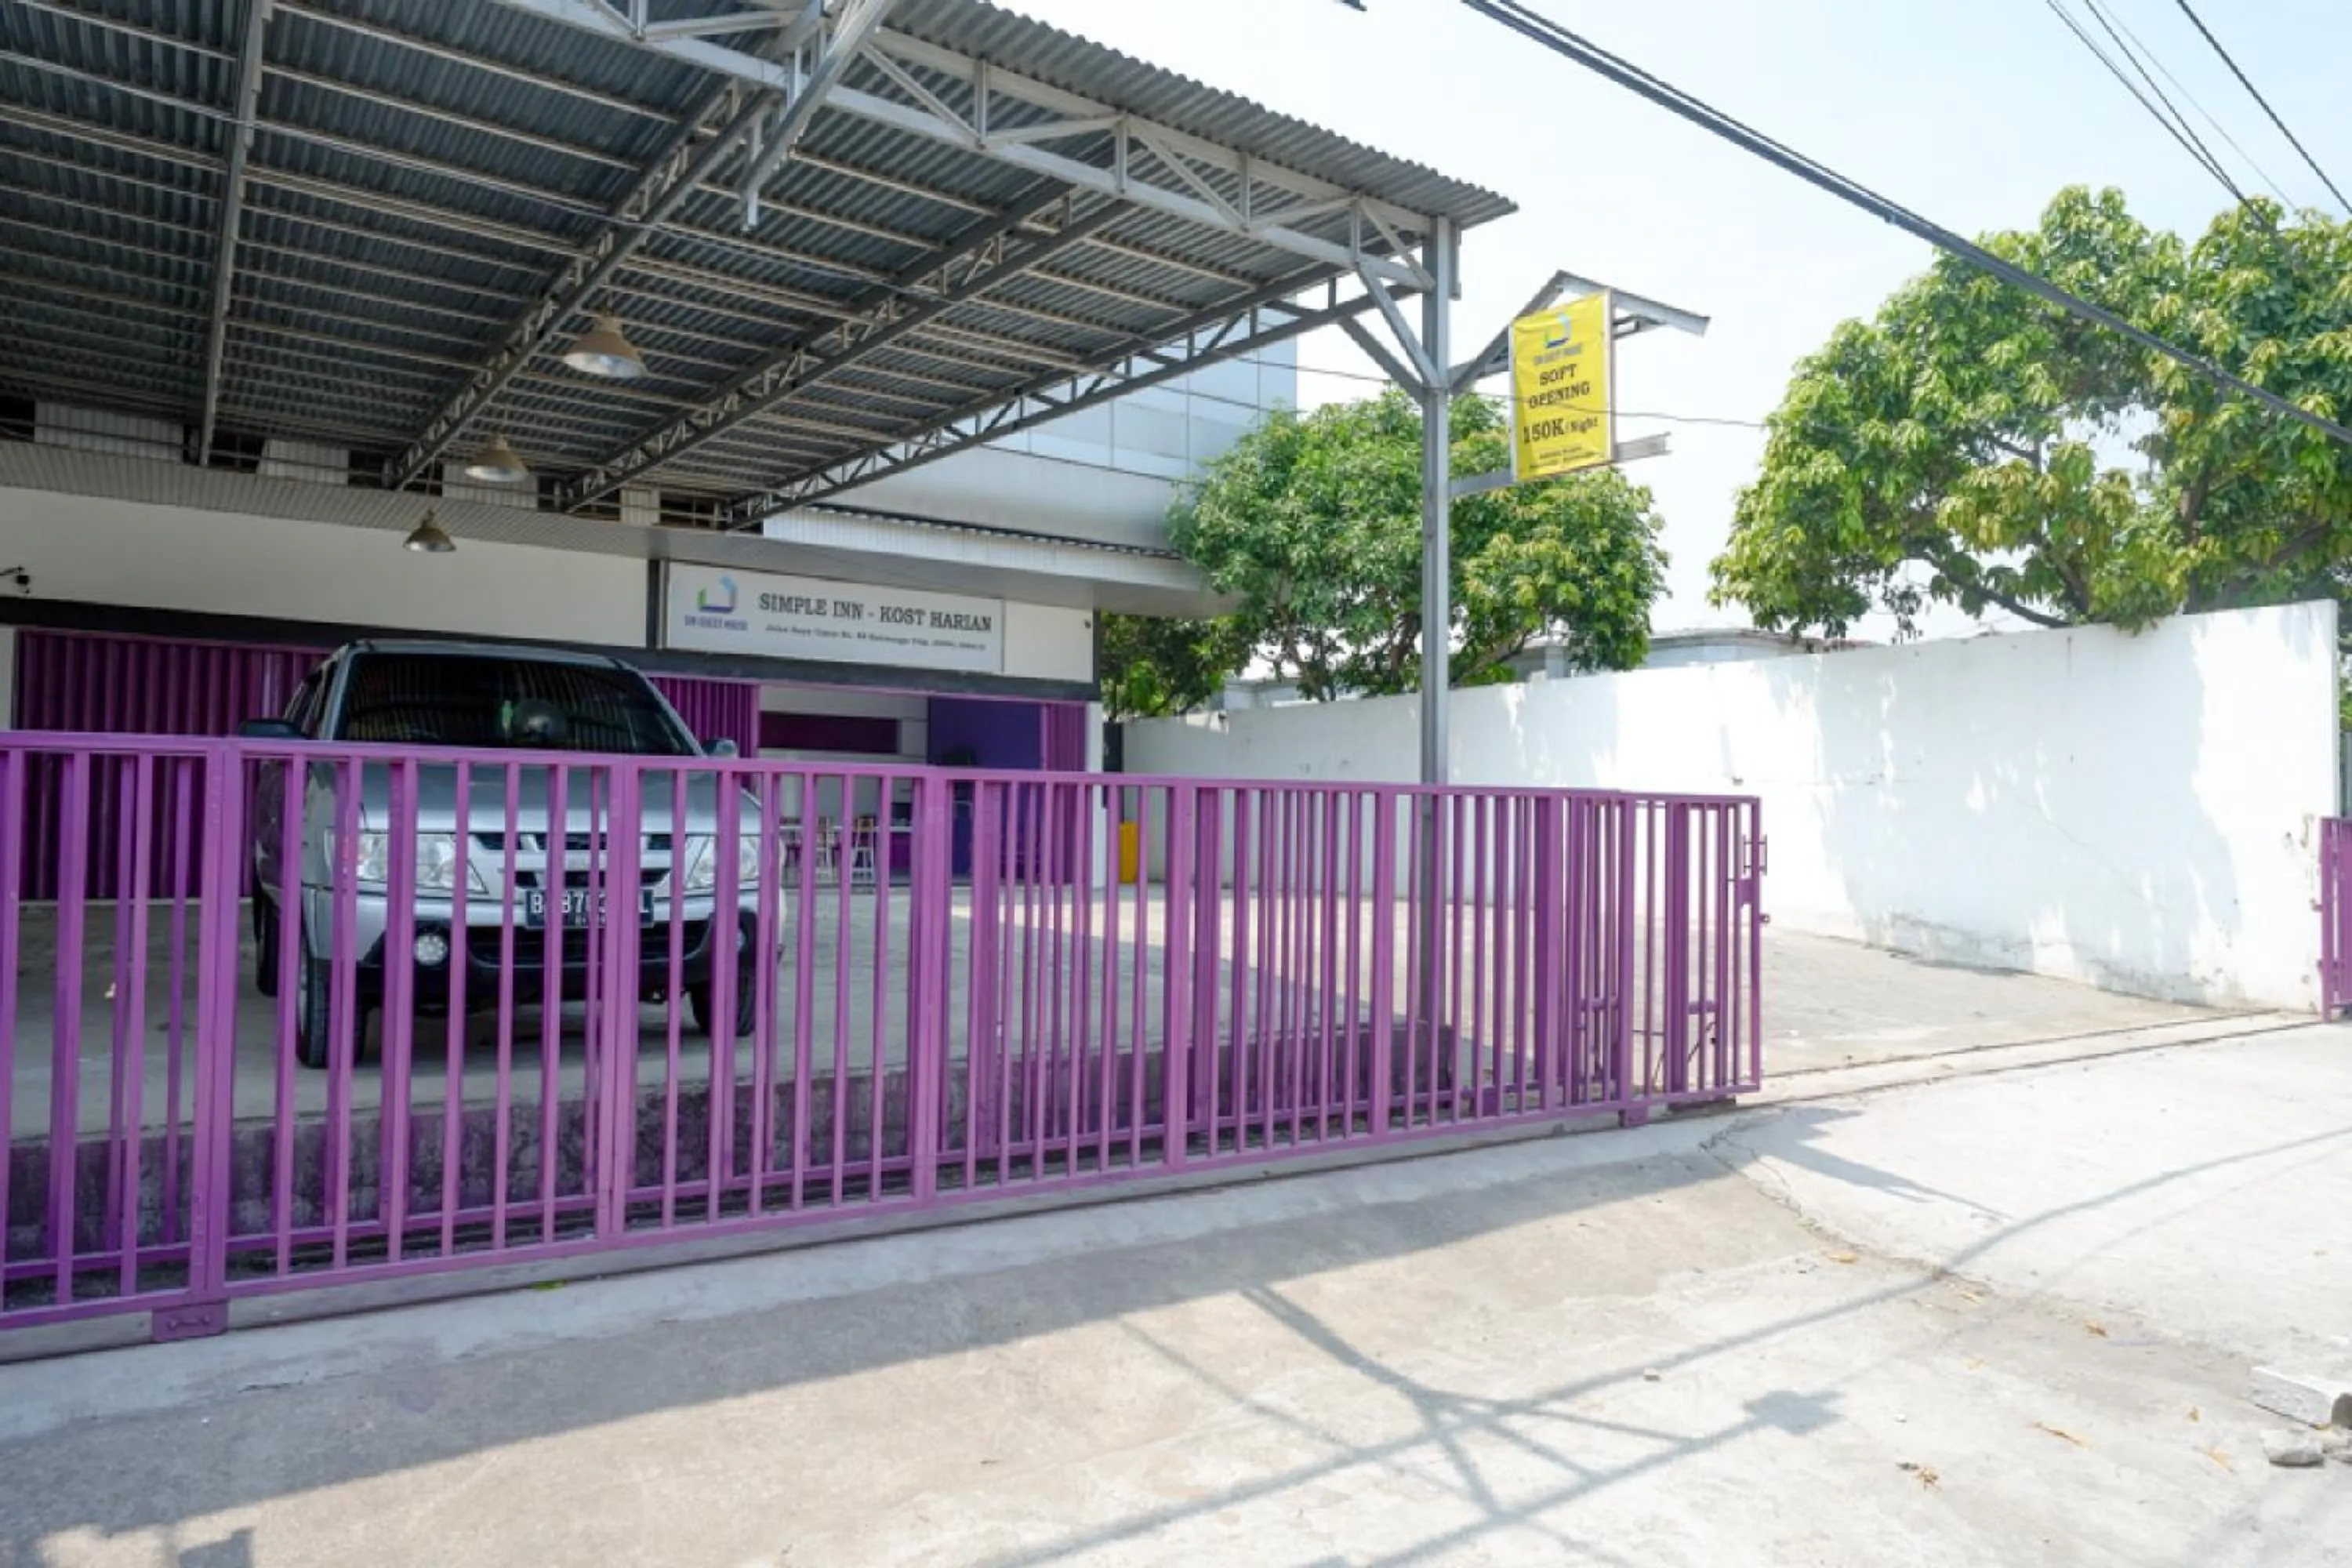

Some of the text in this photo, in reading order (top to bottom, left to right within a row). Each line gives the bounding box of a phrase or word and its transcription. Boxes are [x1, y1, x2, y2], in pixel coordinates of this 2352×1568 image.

[1539, 363, 1577, 386] SOFT
[1530, 381, 1590, 408] OPENING
[1523, 418, 1564, 445] 150K
[759, 593, 827, 616] SIMPLE
[833, 601, 865, 620] INN
[879, 606, 927, 626] KOST
[929, 612, 993, 632] HARIAN
[531, 894, 543, 913] B
